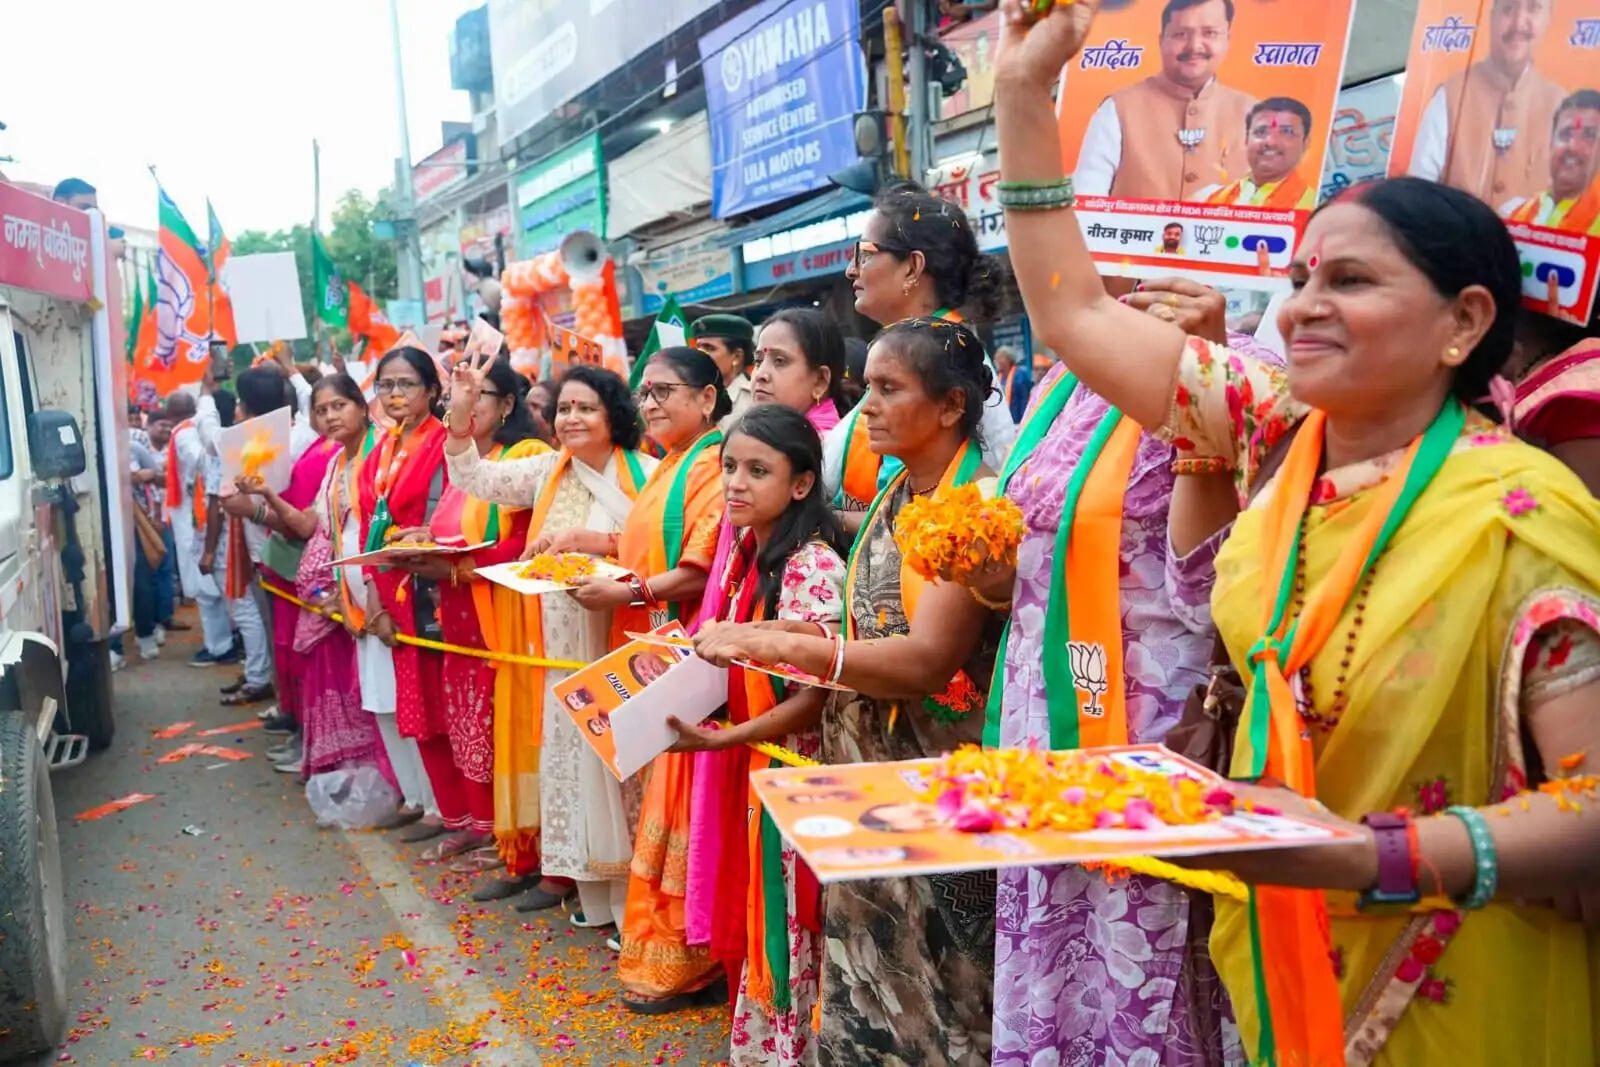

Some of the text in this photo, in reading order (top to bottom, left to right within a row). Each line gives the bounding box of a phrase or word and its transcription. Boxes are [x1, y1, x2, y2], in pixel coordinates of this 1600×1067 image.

[741, 3, 831, 80] YAMAHA
[1422, 16, 1476, 52] हार्दिक
[1080, 39, 1322, 69] हार्दिक स्वागत
[769, 140, 821, 179] MOTORS
[1087, 223, 1155, 244] नीरज कुमार
[604, 672, 631, 702] वागत
